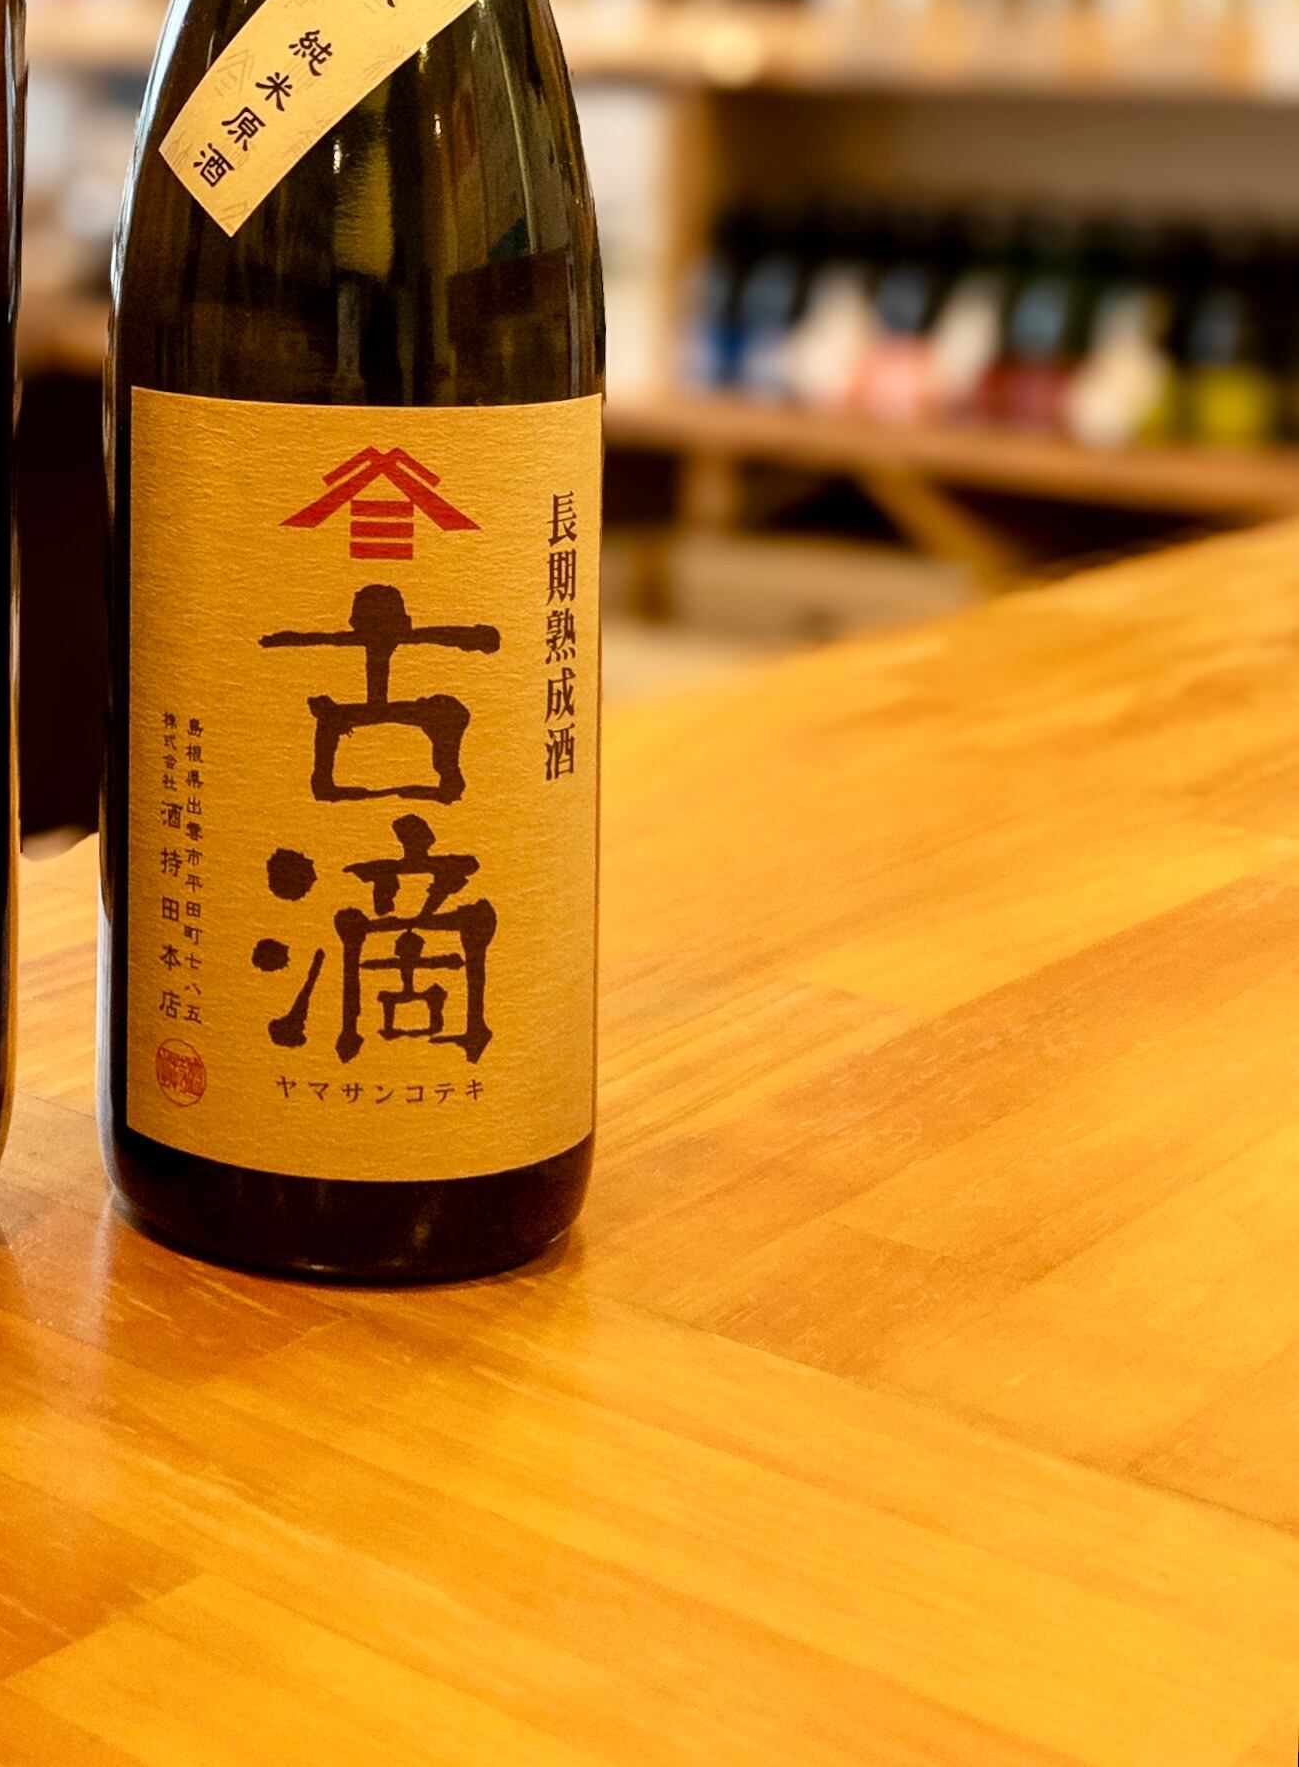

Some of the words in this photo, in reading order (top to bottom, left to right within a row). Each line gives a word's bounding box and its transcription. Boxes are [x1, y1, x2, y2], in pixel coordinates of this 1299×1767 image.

[192, 29, 334, 188] 純米原酒
[544, 490, 578, 781] 長期熟成酒
[251, 583, 501, 1065] 古滴
[275, 1074, 484, 1105] ヤマサンコテキ
